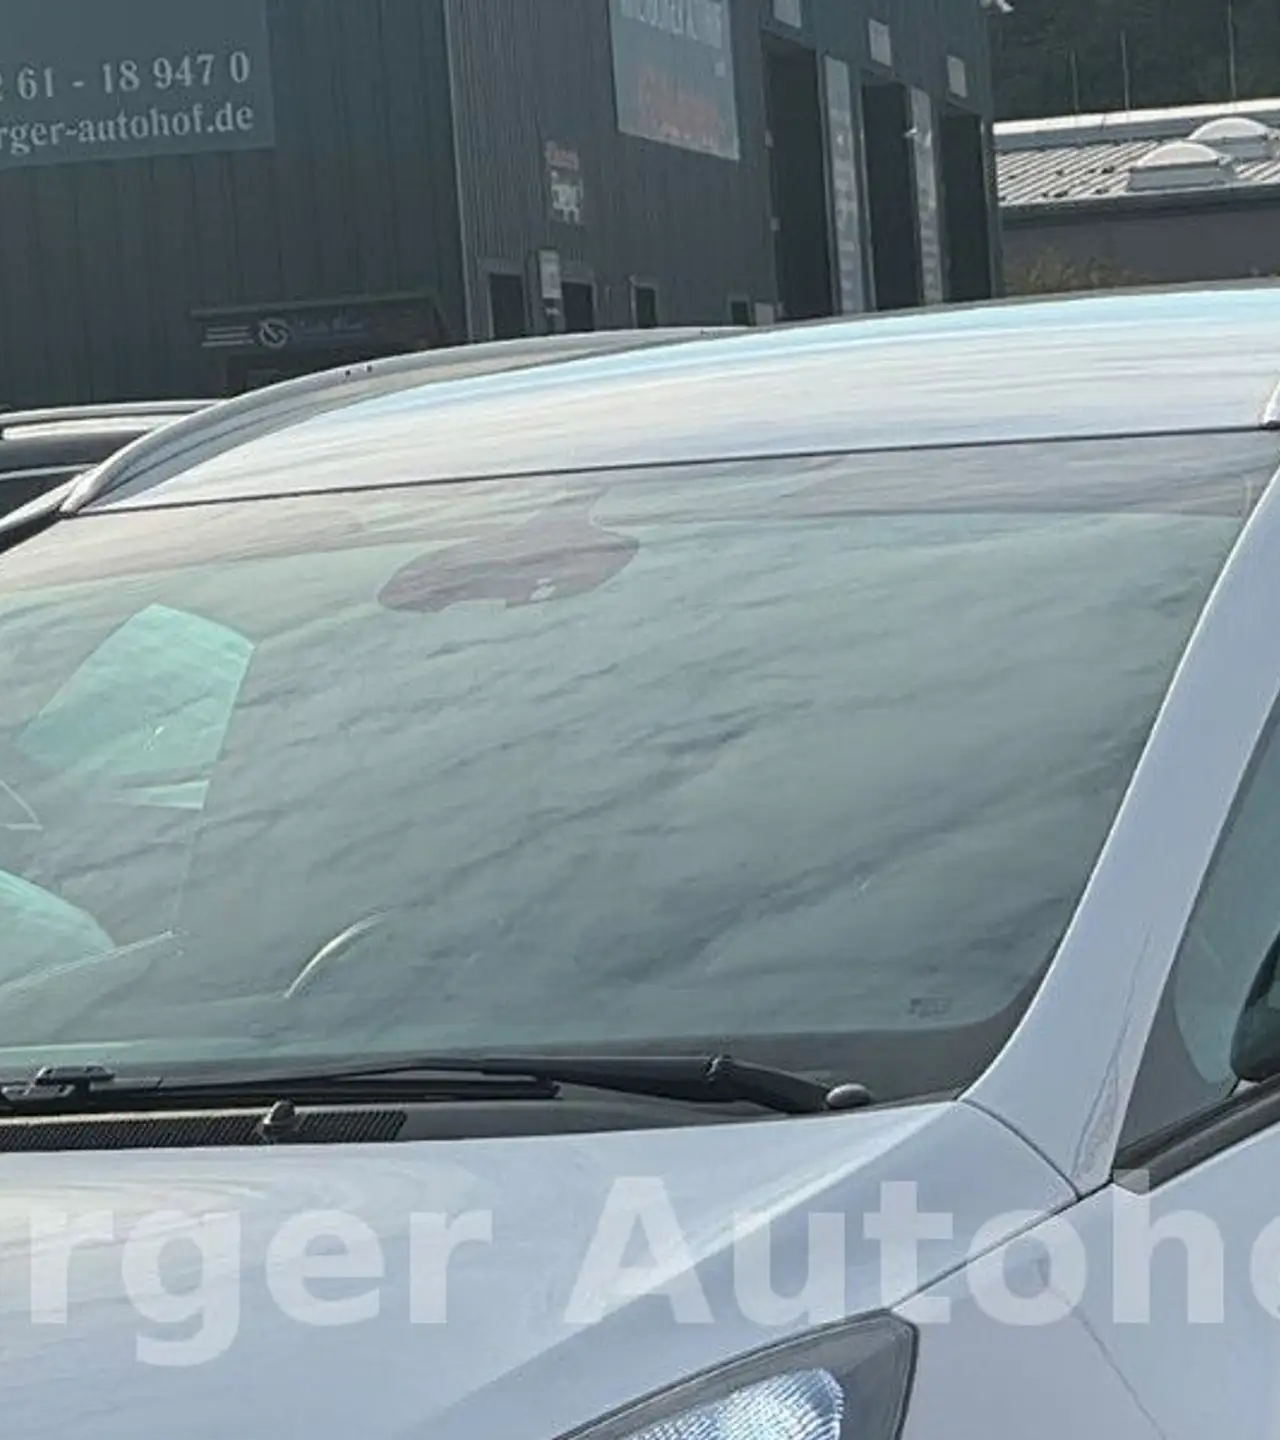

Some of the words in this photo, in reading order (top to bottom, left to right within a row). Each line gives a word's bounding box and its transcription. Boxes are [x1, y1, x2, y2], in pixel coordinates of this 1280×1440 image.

[17, 67, 55, 100] 61
[102, 60, 141, 94] 18
[152, 54, 216, 90] 947
[230, 50, 252, 84] 0
